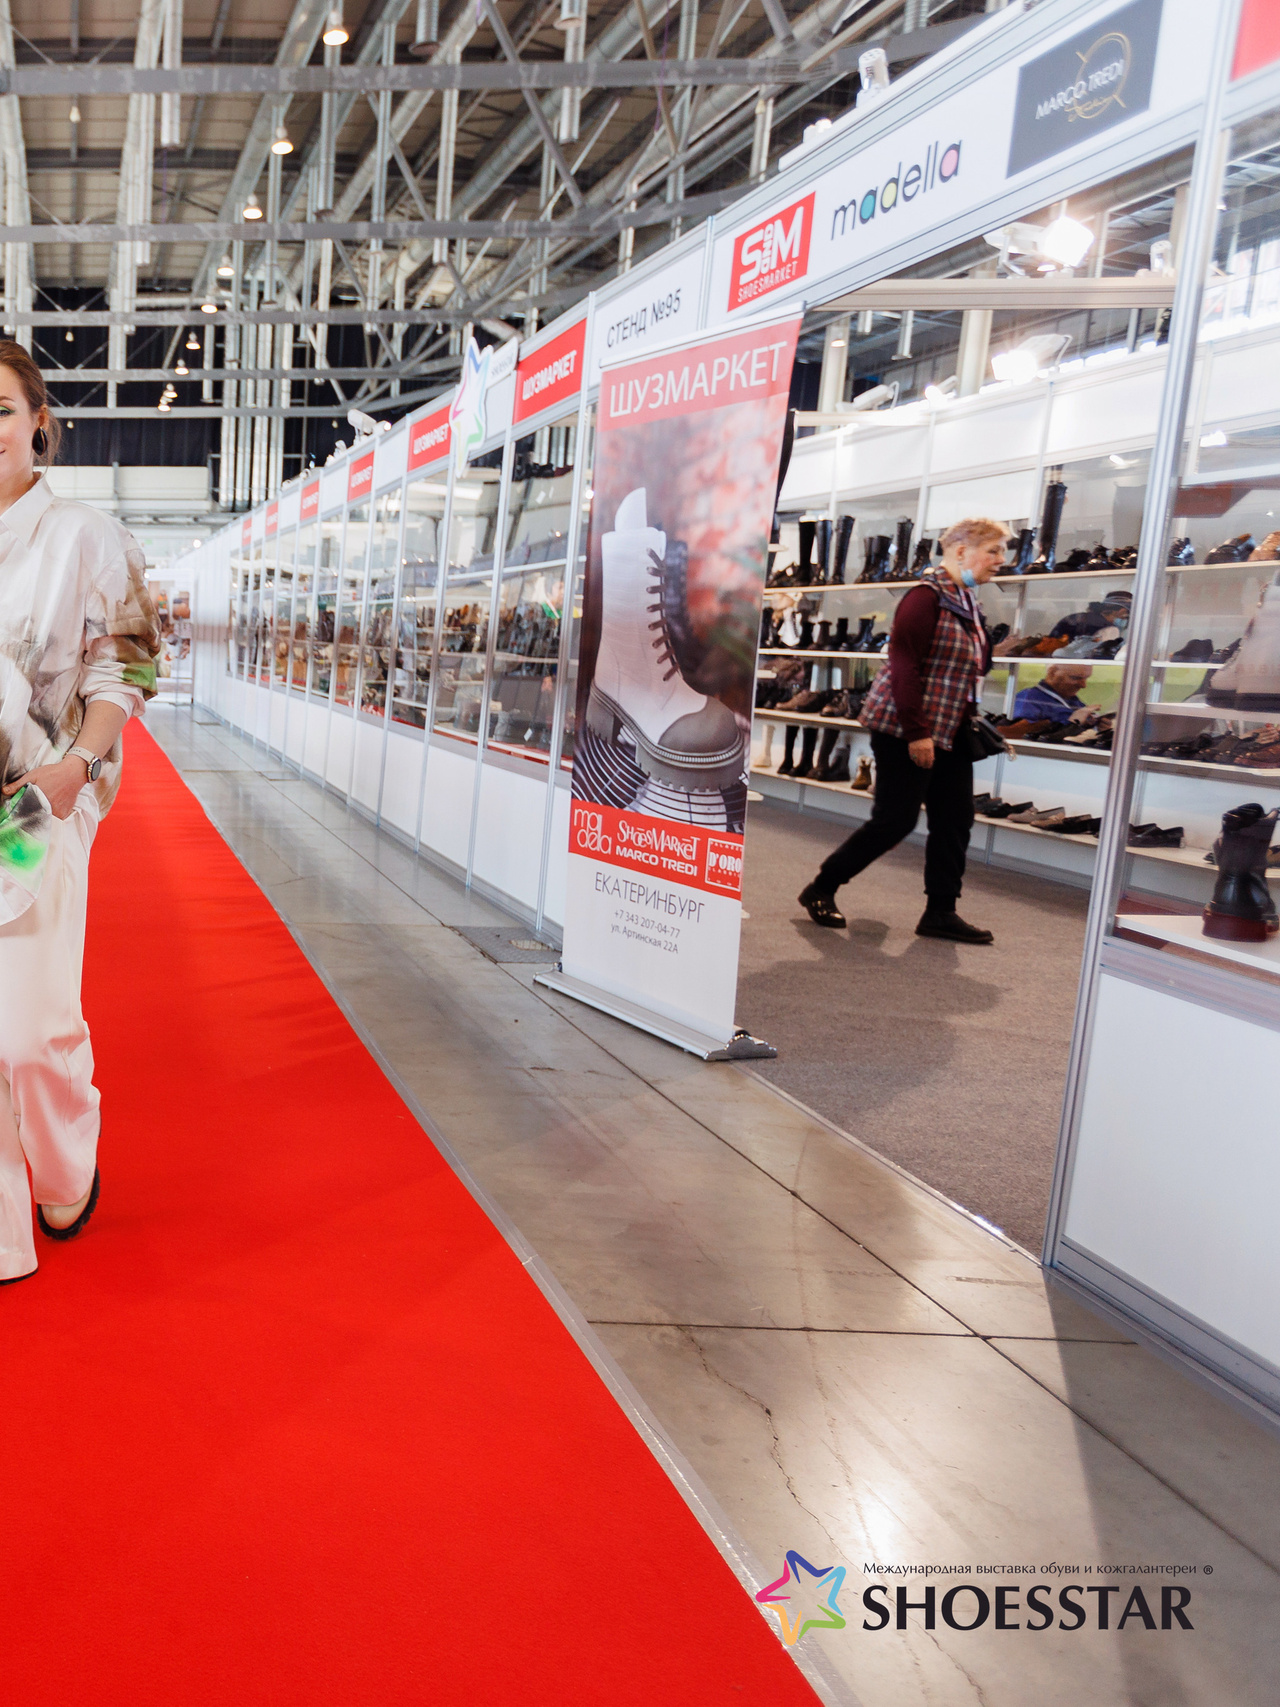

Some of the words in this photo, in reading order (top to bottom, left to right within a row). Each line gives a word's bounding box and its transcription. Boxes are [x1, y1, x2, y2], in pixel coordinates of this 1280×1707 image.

[830, 139, 963, 241] madella
[737, 260, 798, 303] SHOESMARKET
[607, 307, 647, 348] СТЕНД
[650, 288, 682, 327] №95
[522, 350, 577, 401] ШУЗМАРКЕТ
[609, 340, 788, 418] ШУЗМАРКЕТ
[615, 845, 659, 866] MARCO
[660, 856, 698, 877] TREDI
[708, 851, 742, 873] D'ORO
[594, 872, 706, 924] ЕКАТЕРИНБУРГ
[614, 908, 624, 919] +7
[625, 911, 639, 925] 343
[640, 916, 681, 939] 207-04-77
[622, 925, 662, 948] Артинская
